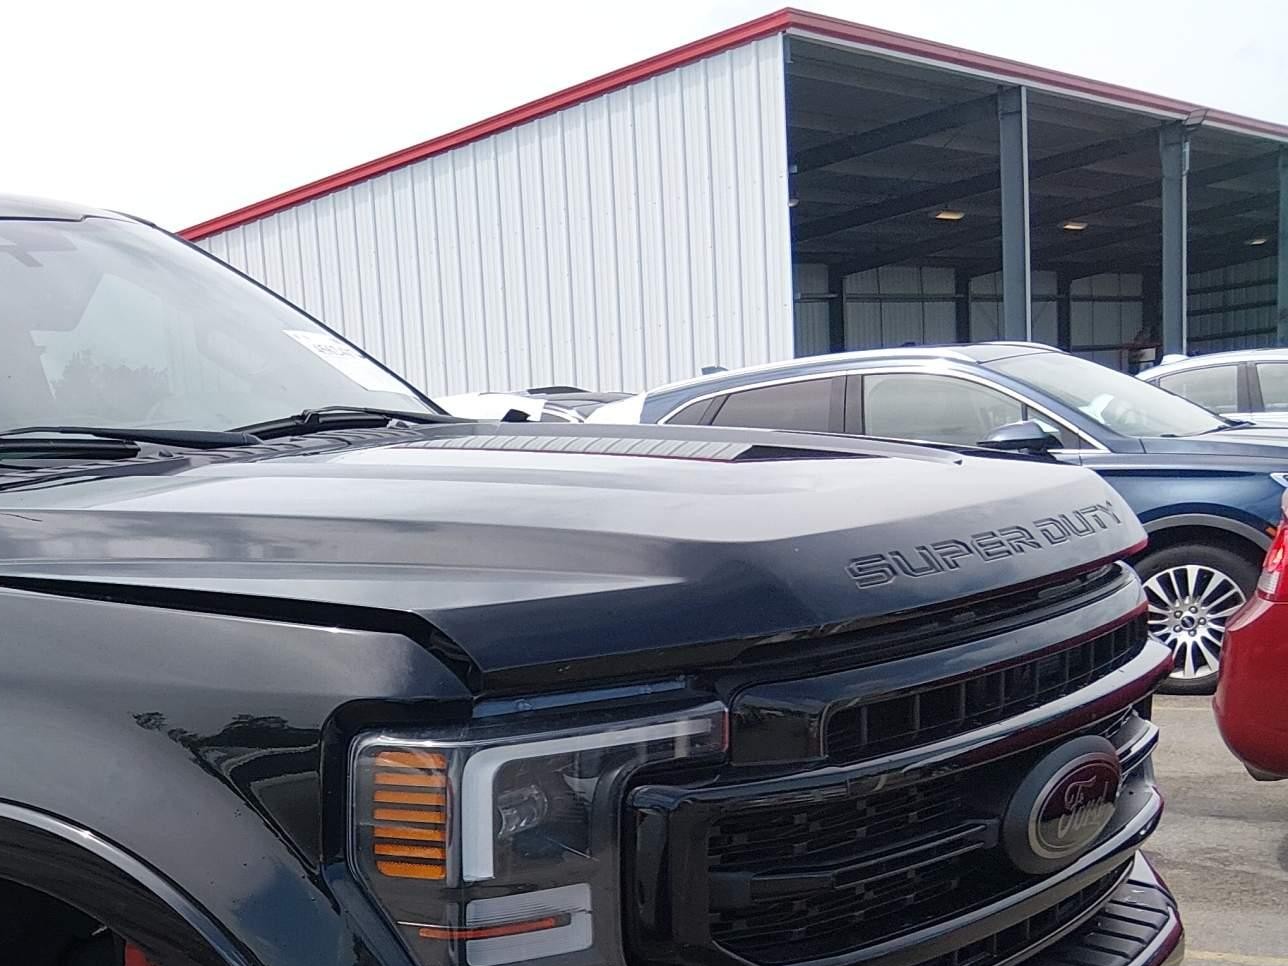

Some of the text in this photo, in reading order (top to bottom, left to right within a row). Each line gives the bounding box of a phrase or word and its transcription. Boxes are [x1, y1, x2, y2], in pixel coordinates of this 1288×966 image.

[844, 500, 1123, 590] SUPER DUTY
[1058, 775, 1110, 839] Ford
